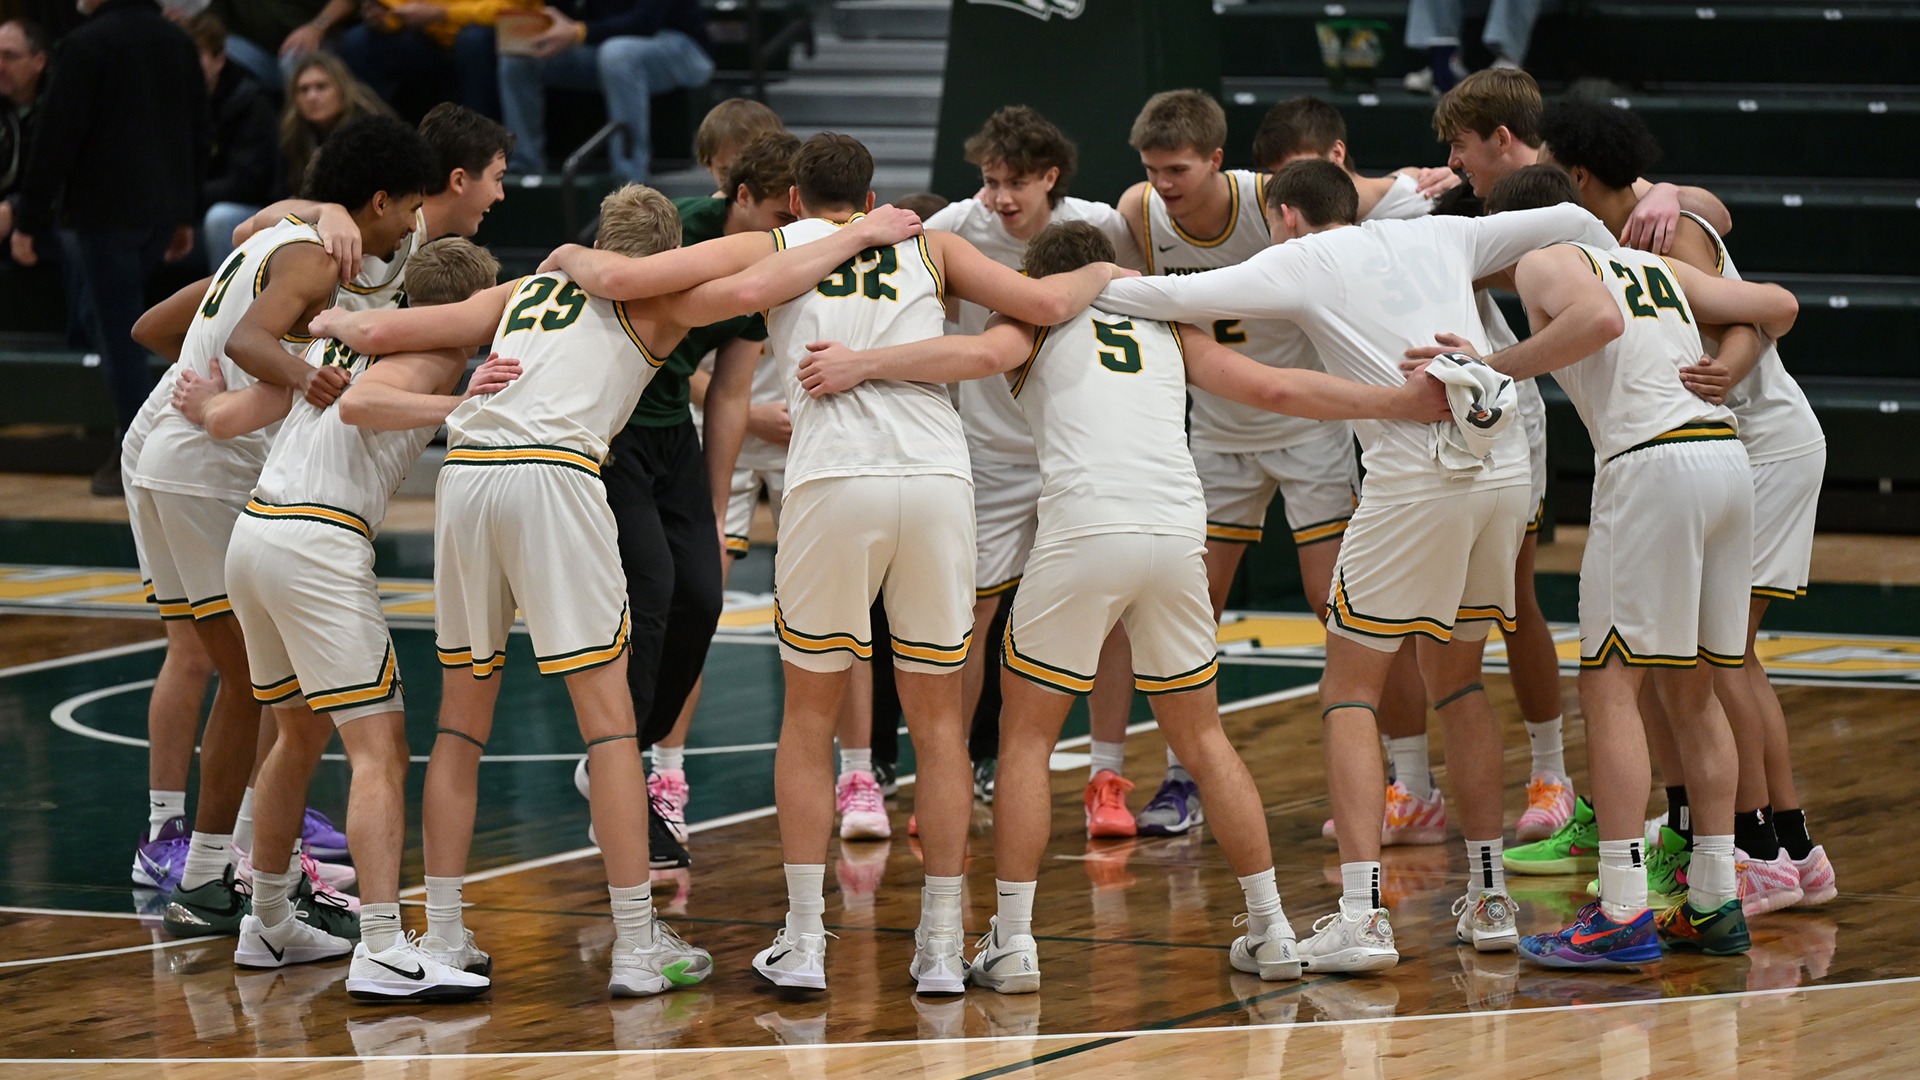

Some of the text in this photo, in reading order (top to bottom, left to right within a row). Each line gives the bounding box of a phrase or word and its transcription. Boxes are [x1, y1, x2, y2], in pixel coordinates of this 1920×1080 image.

[815, 245, 900, 302] 32
[1608, 260, 1692, 326] 24
[502, 276, 590, 338] 25
[1091, 317, 1144, 374] 5
